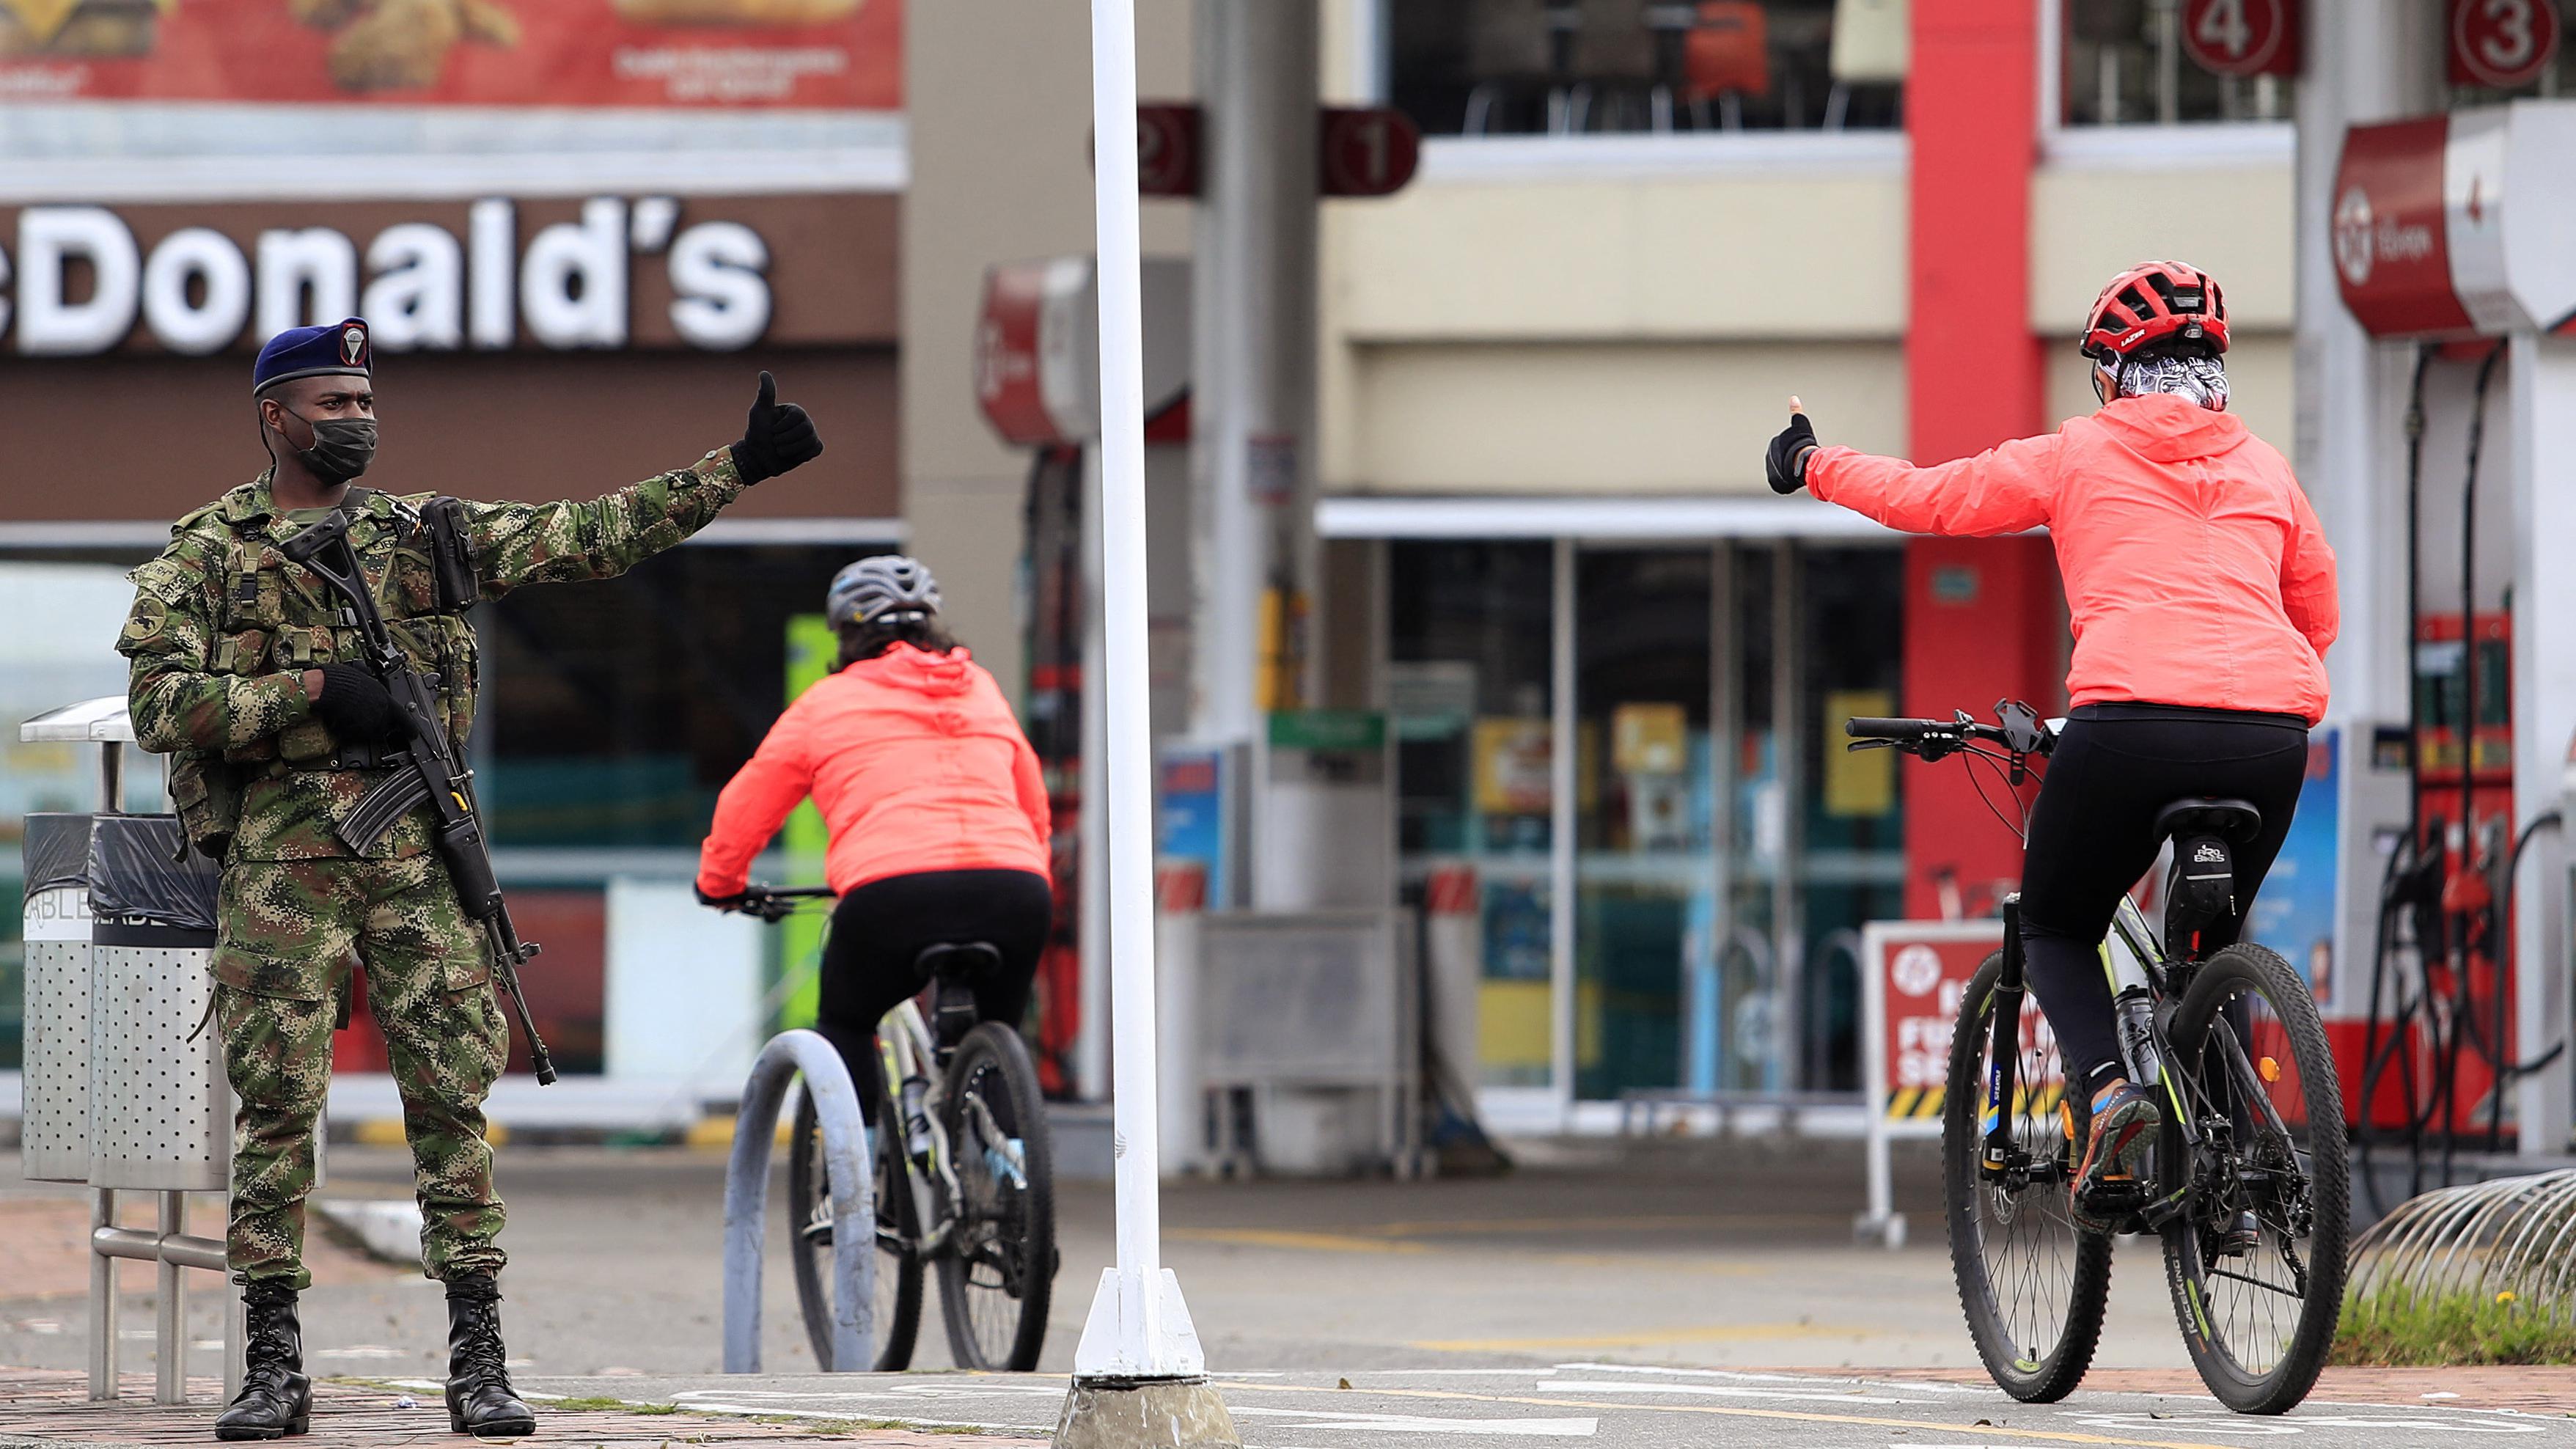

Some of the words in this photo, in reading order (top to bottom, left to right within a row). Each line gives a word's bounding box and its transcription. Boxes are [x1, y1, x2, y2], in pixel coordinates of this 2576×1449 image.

[2198, 0, 2252, 56] 4
[2480, 0, 2536, 67] 3
[1357, 120, 1388, 183] 1
[0, 195, 771, 358] Donald's
[2121, 329, 2146, 347] LAZER
[23, 887, 93, 920] ABLE
